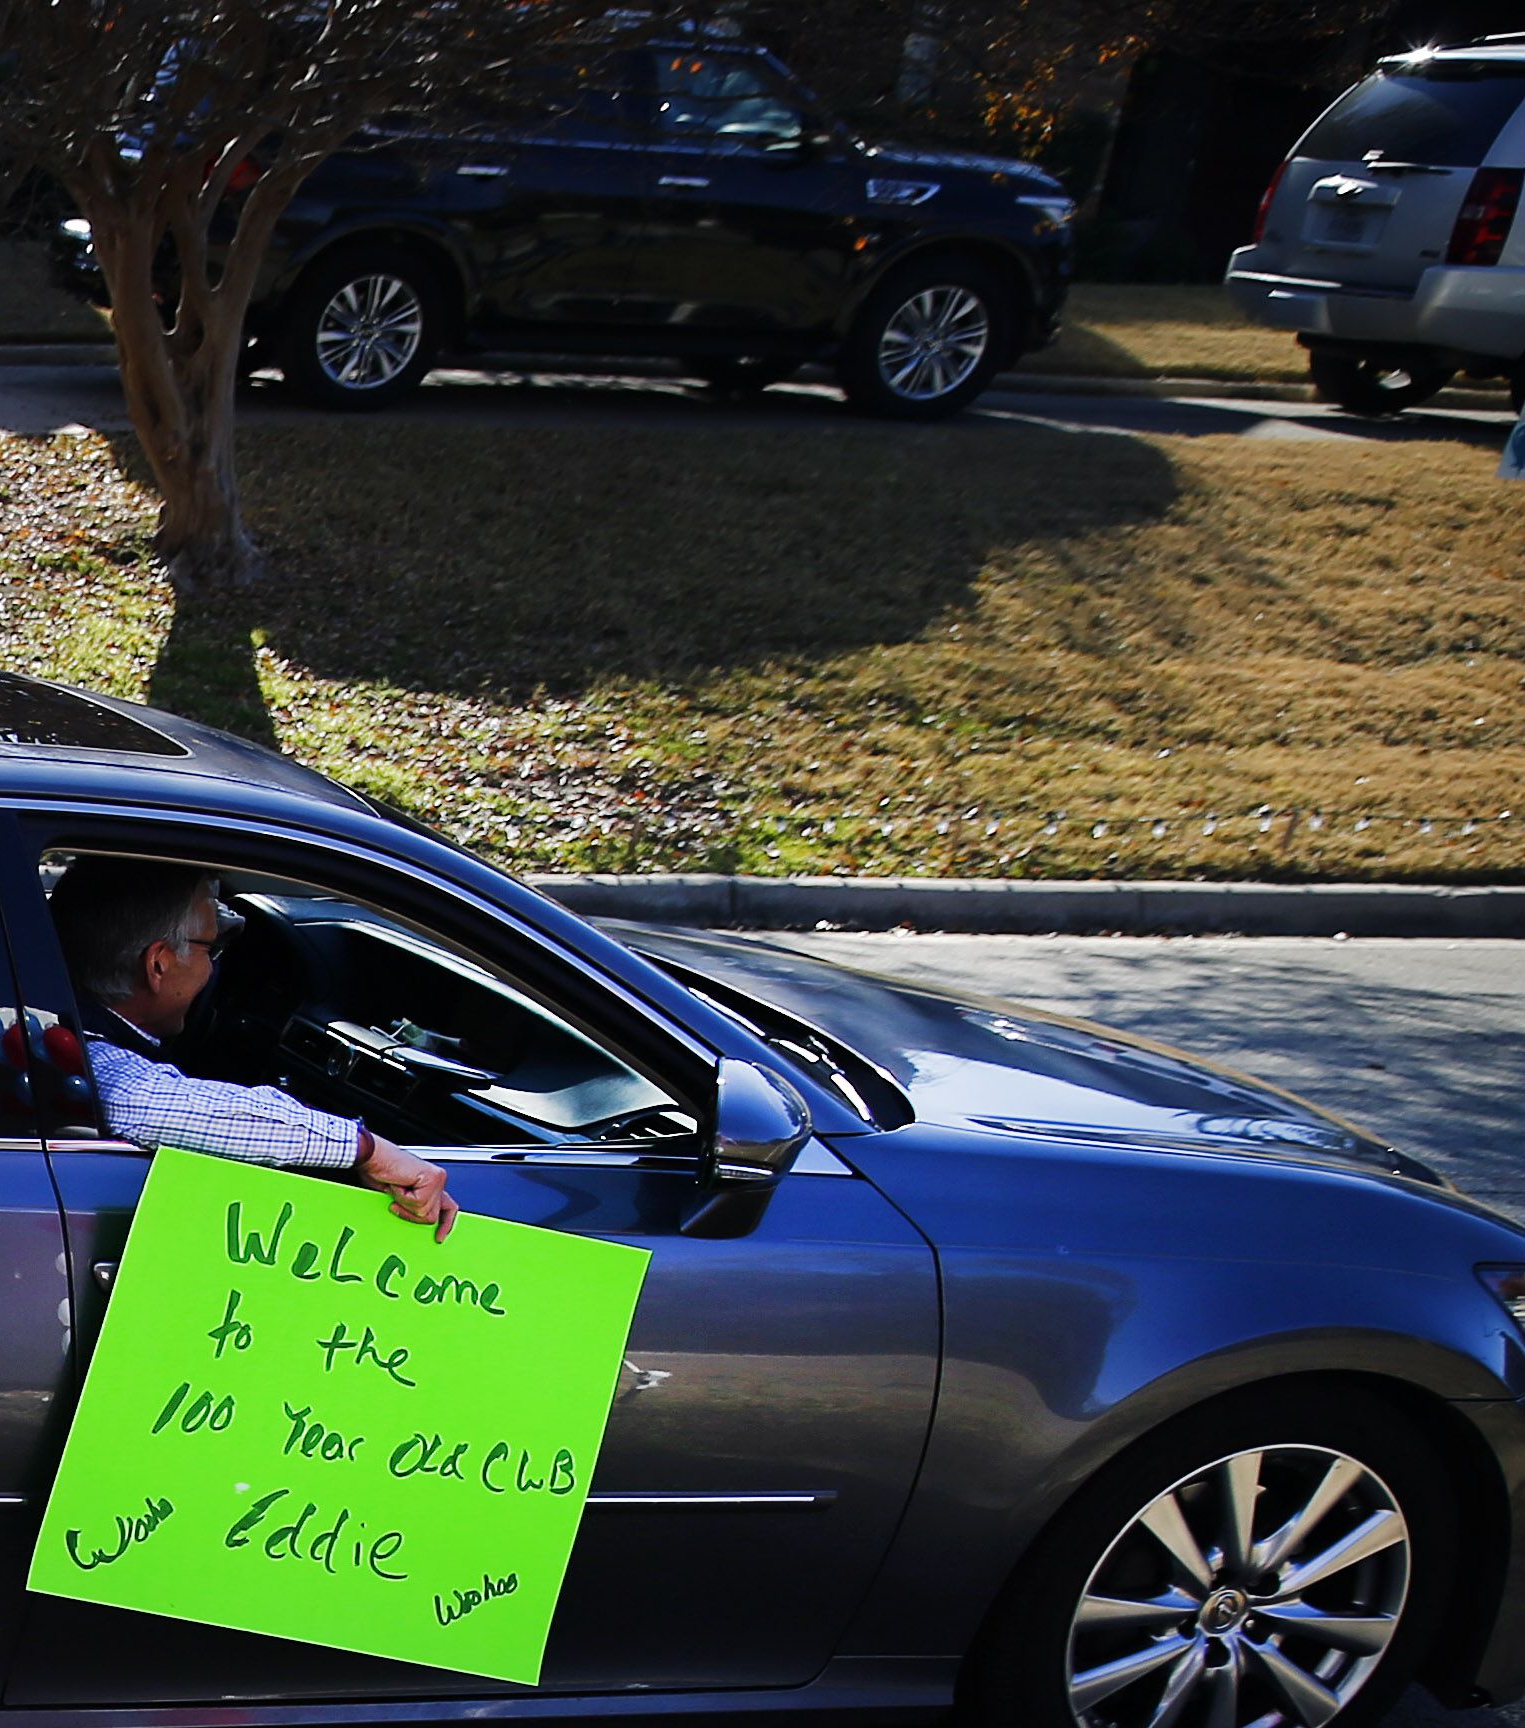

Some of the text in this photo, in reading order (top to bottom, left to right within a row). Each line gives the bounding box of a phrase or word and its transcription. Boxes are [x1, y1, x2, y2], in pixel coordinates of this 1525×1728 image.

[208, 1290, 416, 1387] to the
[153, 1383, 235, 1435] 100
[284, 1402, 365, 1461] Year
[225, 1490, 408, 1580] Eddie
